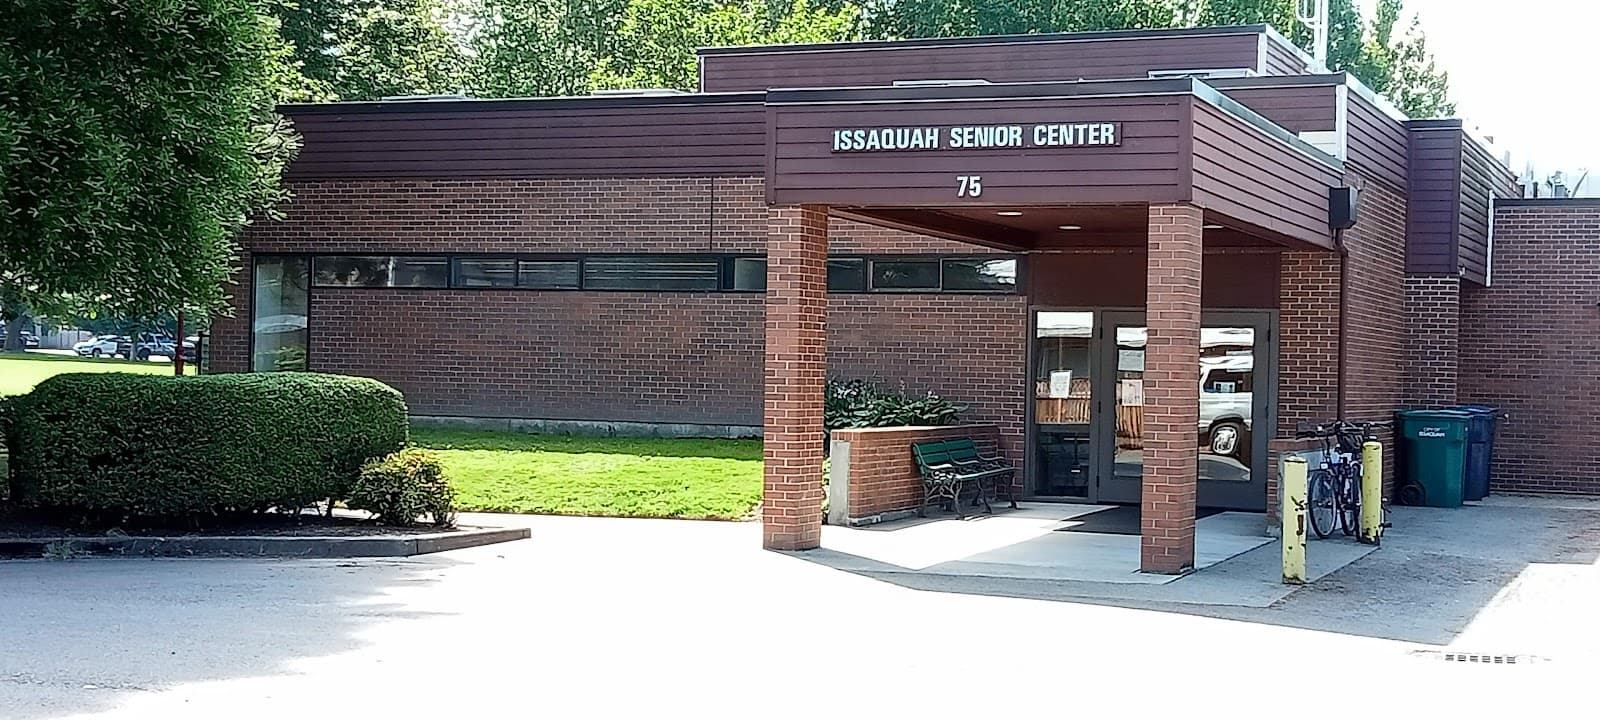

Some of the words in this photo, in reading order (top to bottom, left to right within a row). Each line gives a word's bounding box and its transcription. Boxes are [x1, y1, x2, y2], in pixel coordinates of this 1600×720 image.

[833, 128, 939, 151] ISSAQUAH
[949, 126, 1022, 148] SENIOR
[1033, 123, 1115, 146] CENTER
[956, 175, 982, 197] 75
